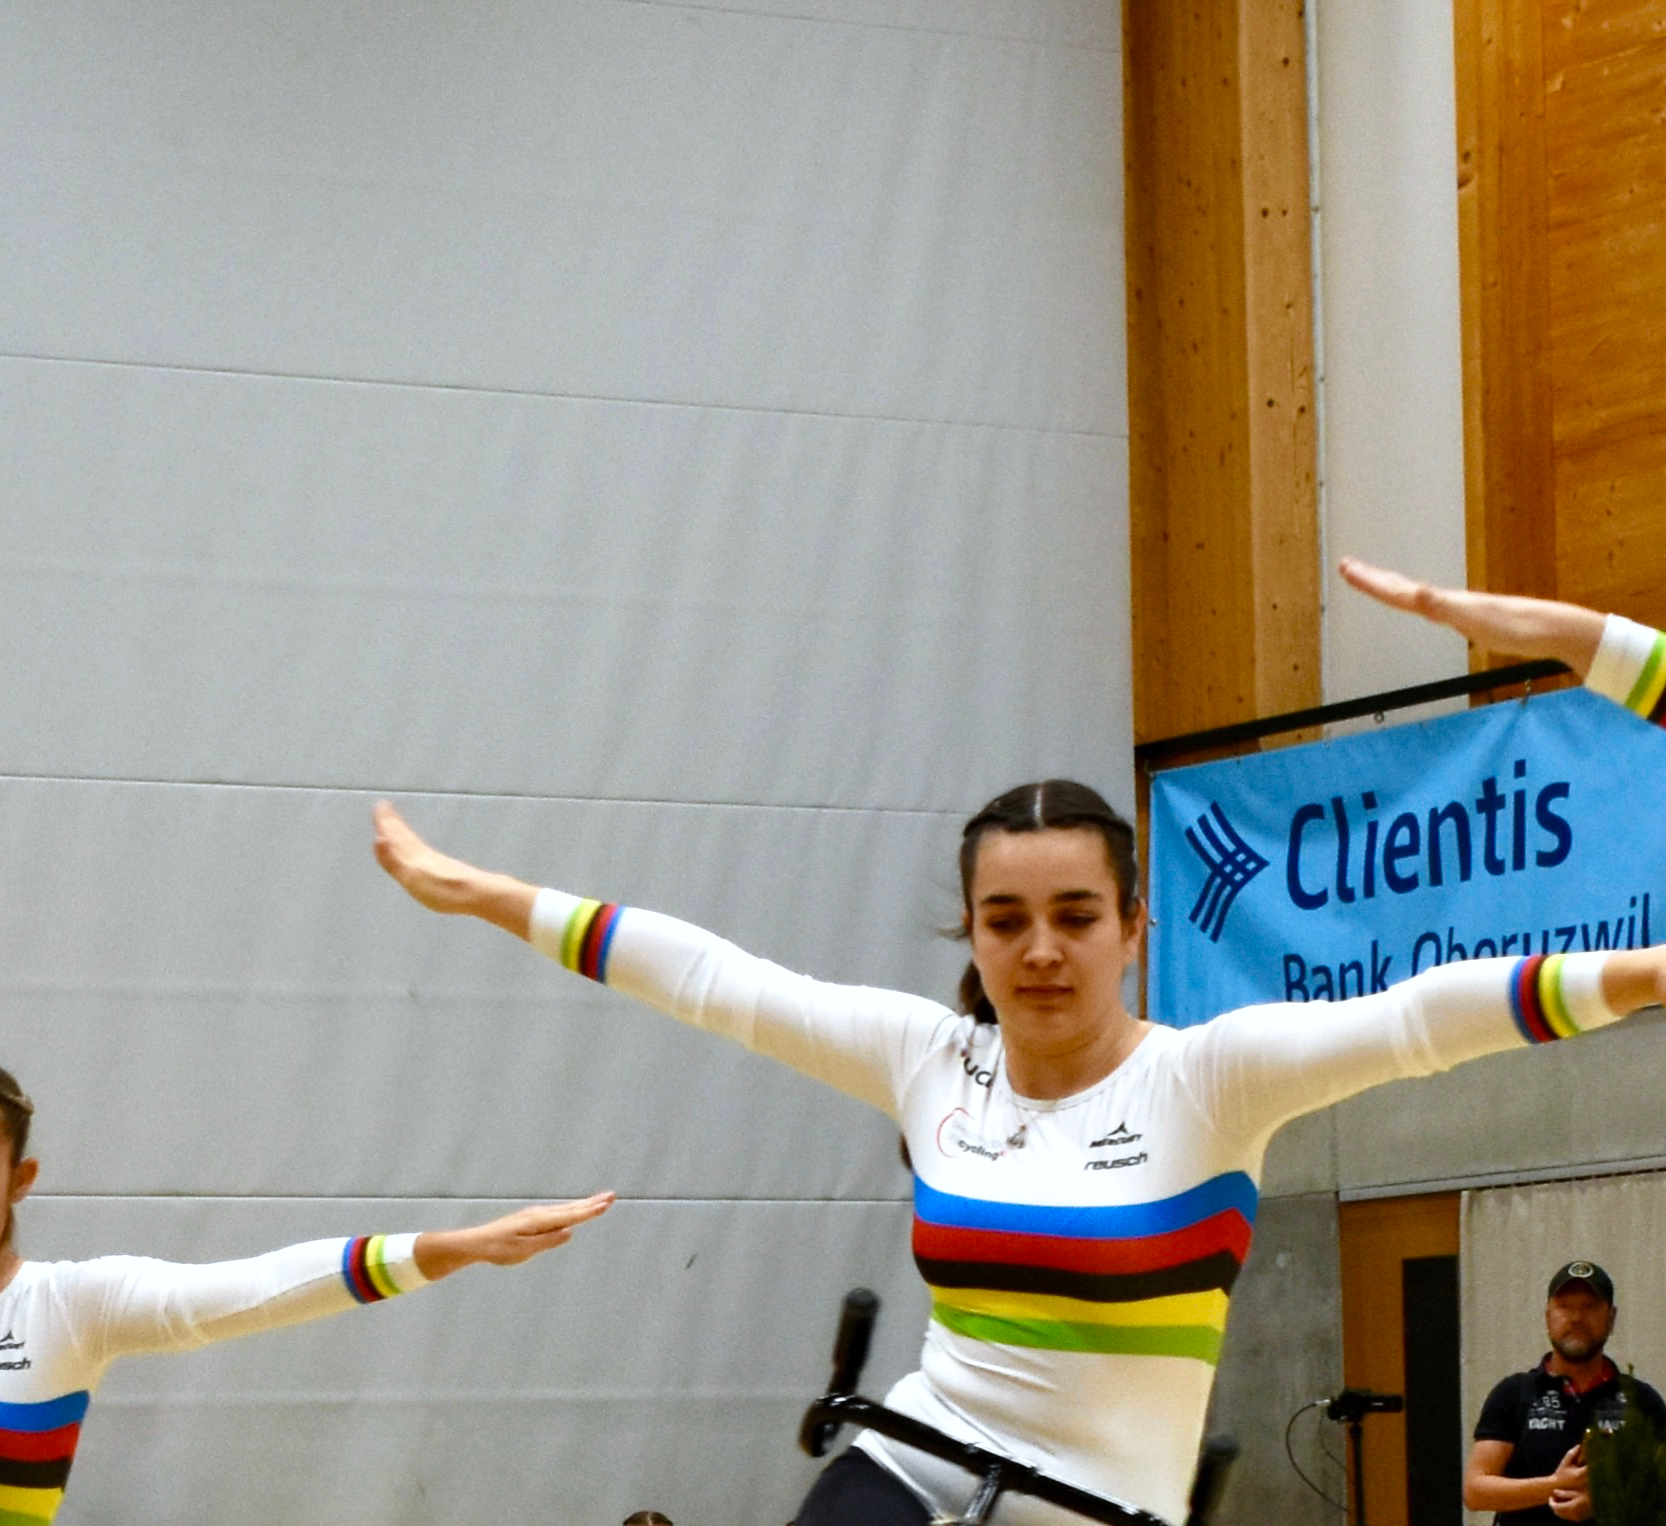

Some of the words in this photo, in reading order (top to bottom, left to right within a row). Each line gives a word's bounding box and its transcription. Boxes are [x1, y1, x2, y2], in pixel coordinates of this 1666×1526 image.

[1286, 759, 1573, 911] Clientis
[1284, 940, 1392, 1002] Bank
[1084, 1151, 1148, 1171] reusch
